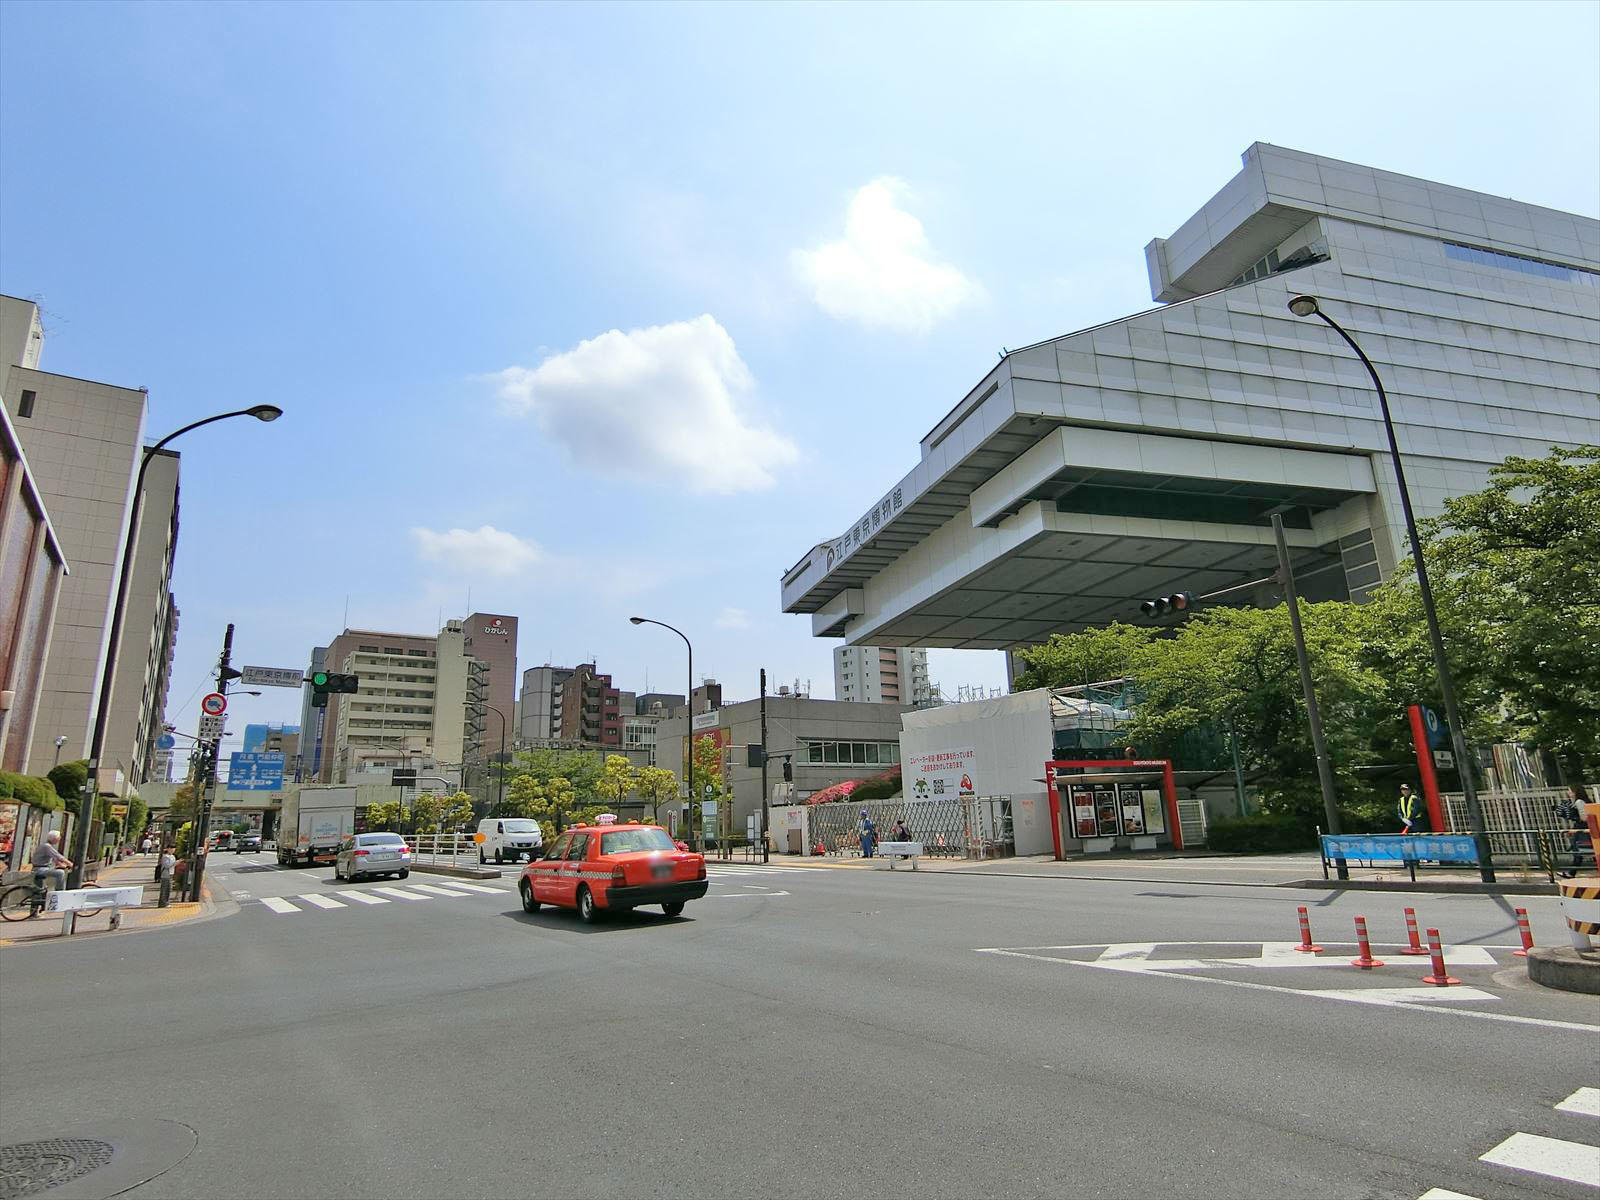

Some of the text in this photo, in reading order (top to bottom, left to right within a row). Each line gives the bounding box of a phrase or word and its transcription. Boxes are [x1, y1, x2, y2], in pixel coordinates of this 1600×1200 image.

[836, 488, 903, 561] 江戸東京博物館
[484, 626, 508, 635] ひがしん
